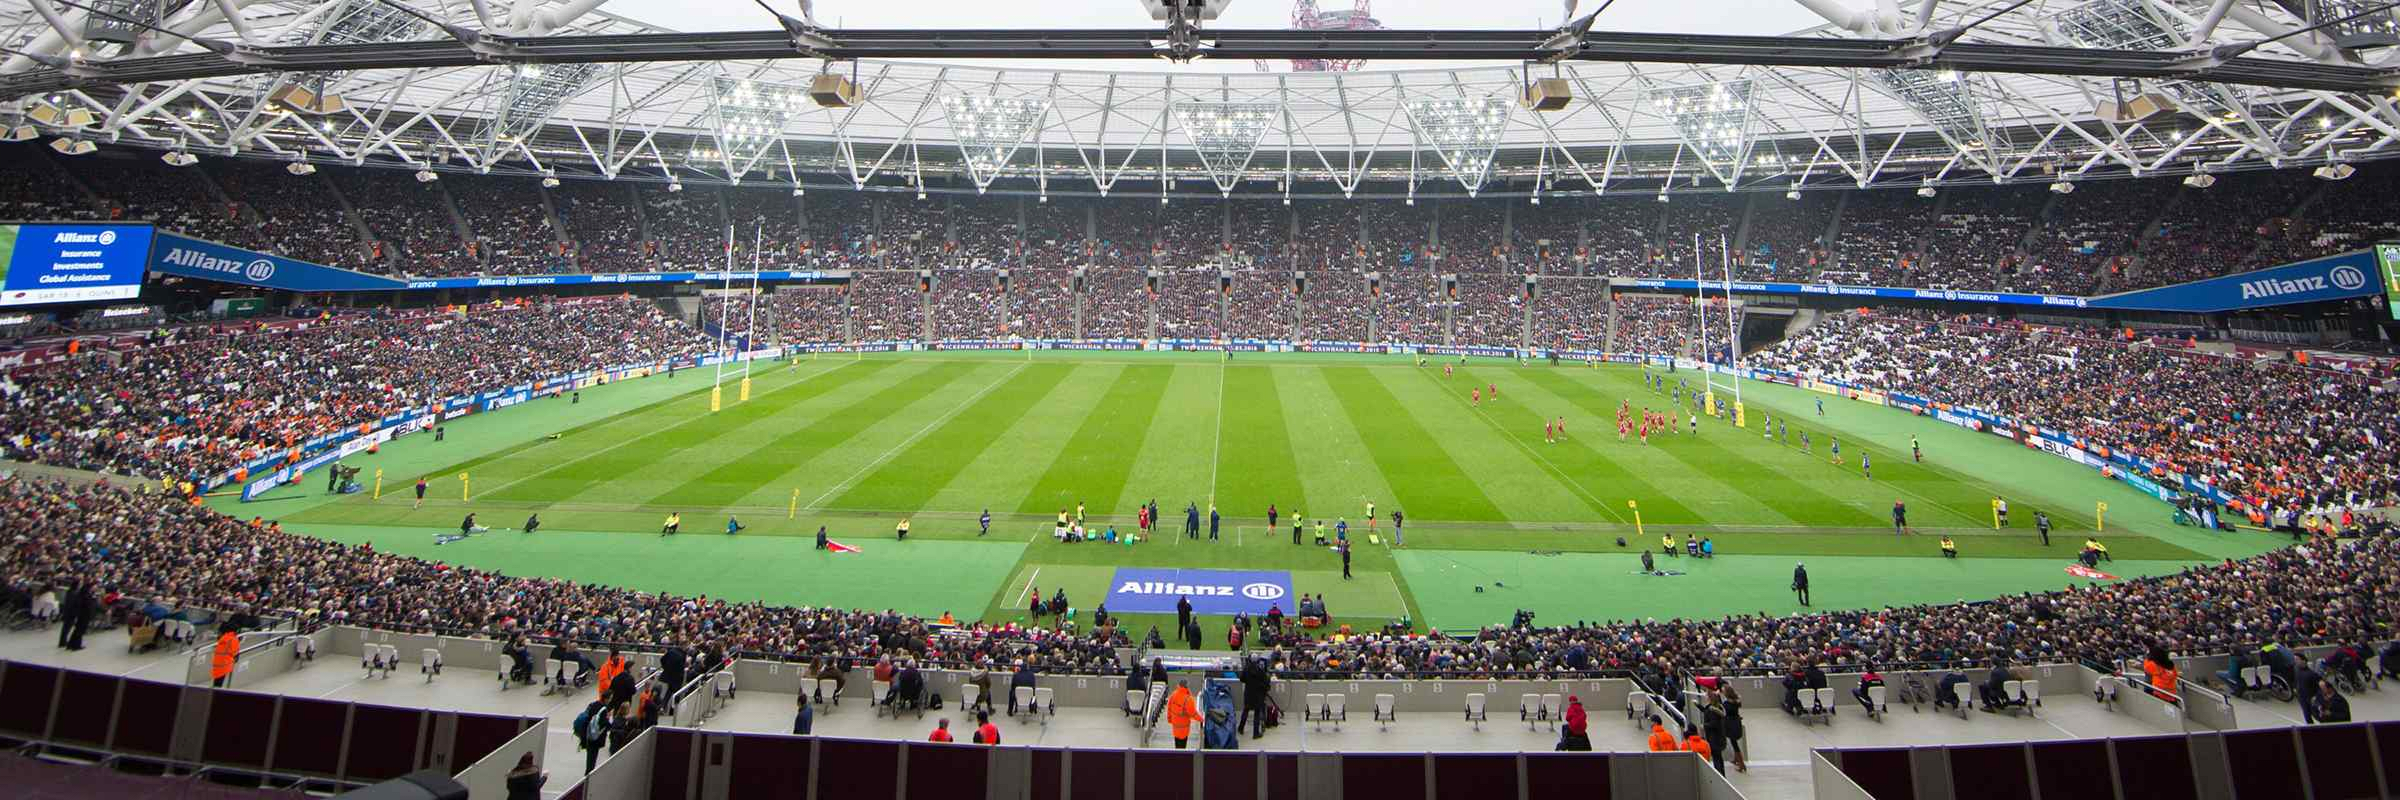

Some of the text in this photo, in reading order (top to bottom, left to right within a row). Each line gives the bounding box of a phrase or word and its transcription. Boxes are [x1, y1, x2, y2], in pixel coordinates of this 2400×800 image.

[54, 232, 98, 243] Allianz
[60, 250, 102, 258] Insurance
[52, 262, 104, 271] Investments
[162, 248, 243, 274] Allianz
[39, 273, 112, 284] Global Assistance
[477, 276, 555, 286] Allianz Insurance
[590, 272, 661, 283] Allianz Insurance
[409, 281, 437, 289] urance
[1732, 282, 1766, 291] Insurance
[1800, 285, 1876, 296] Allianz Insurance
[2240, 275, 2328, 299] Allianz
[1915, 289, 1999, 302] Allianz Insurance
[2042, 296, 2075, 306] Allianz
[2044, 440, 2072, 458] BLK
[1117, 581, 1235, 596] Allianz
